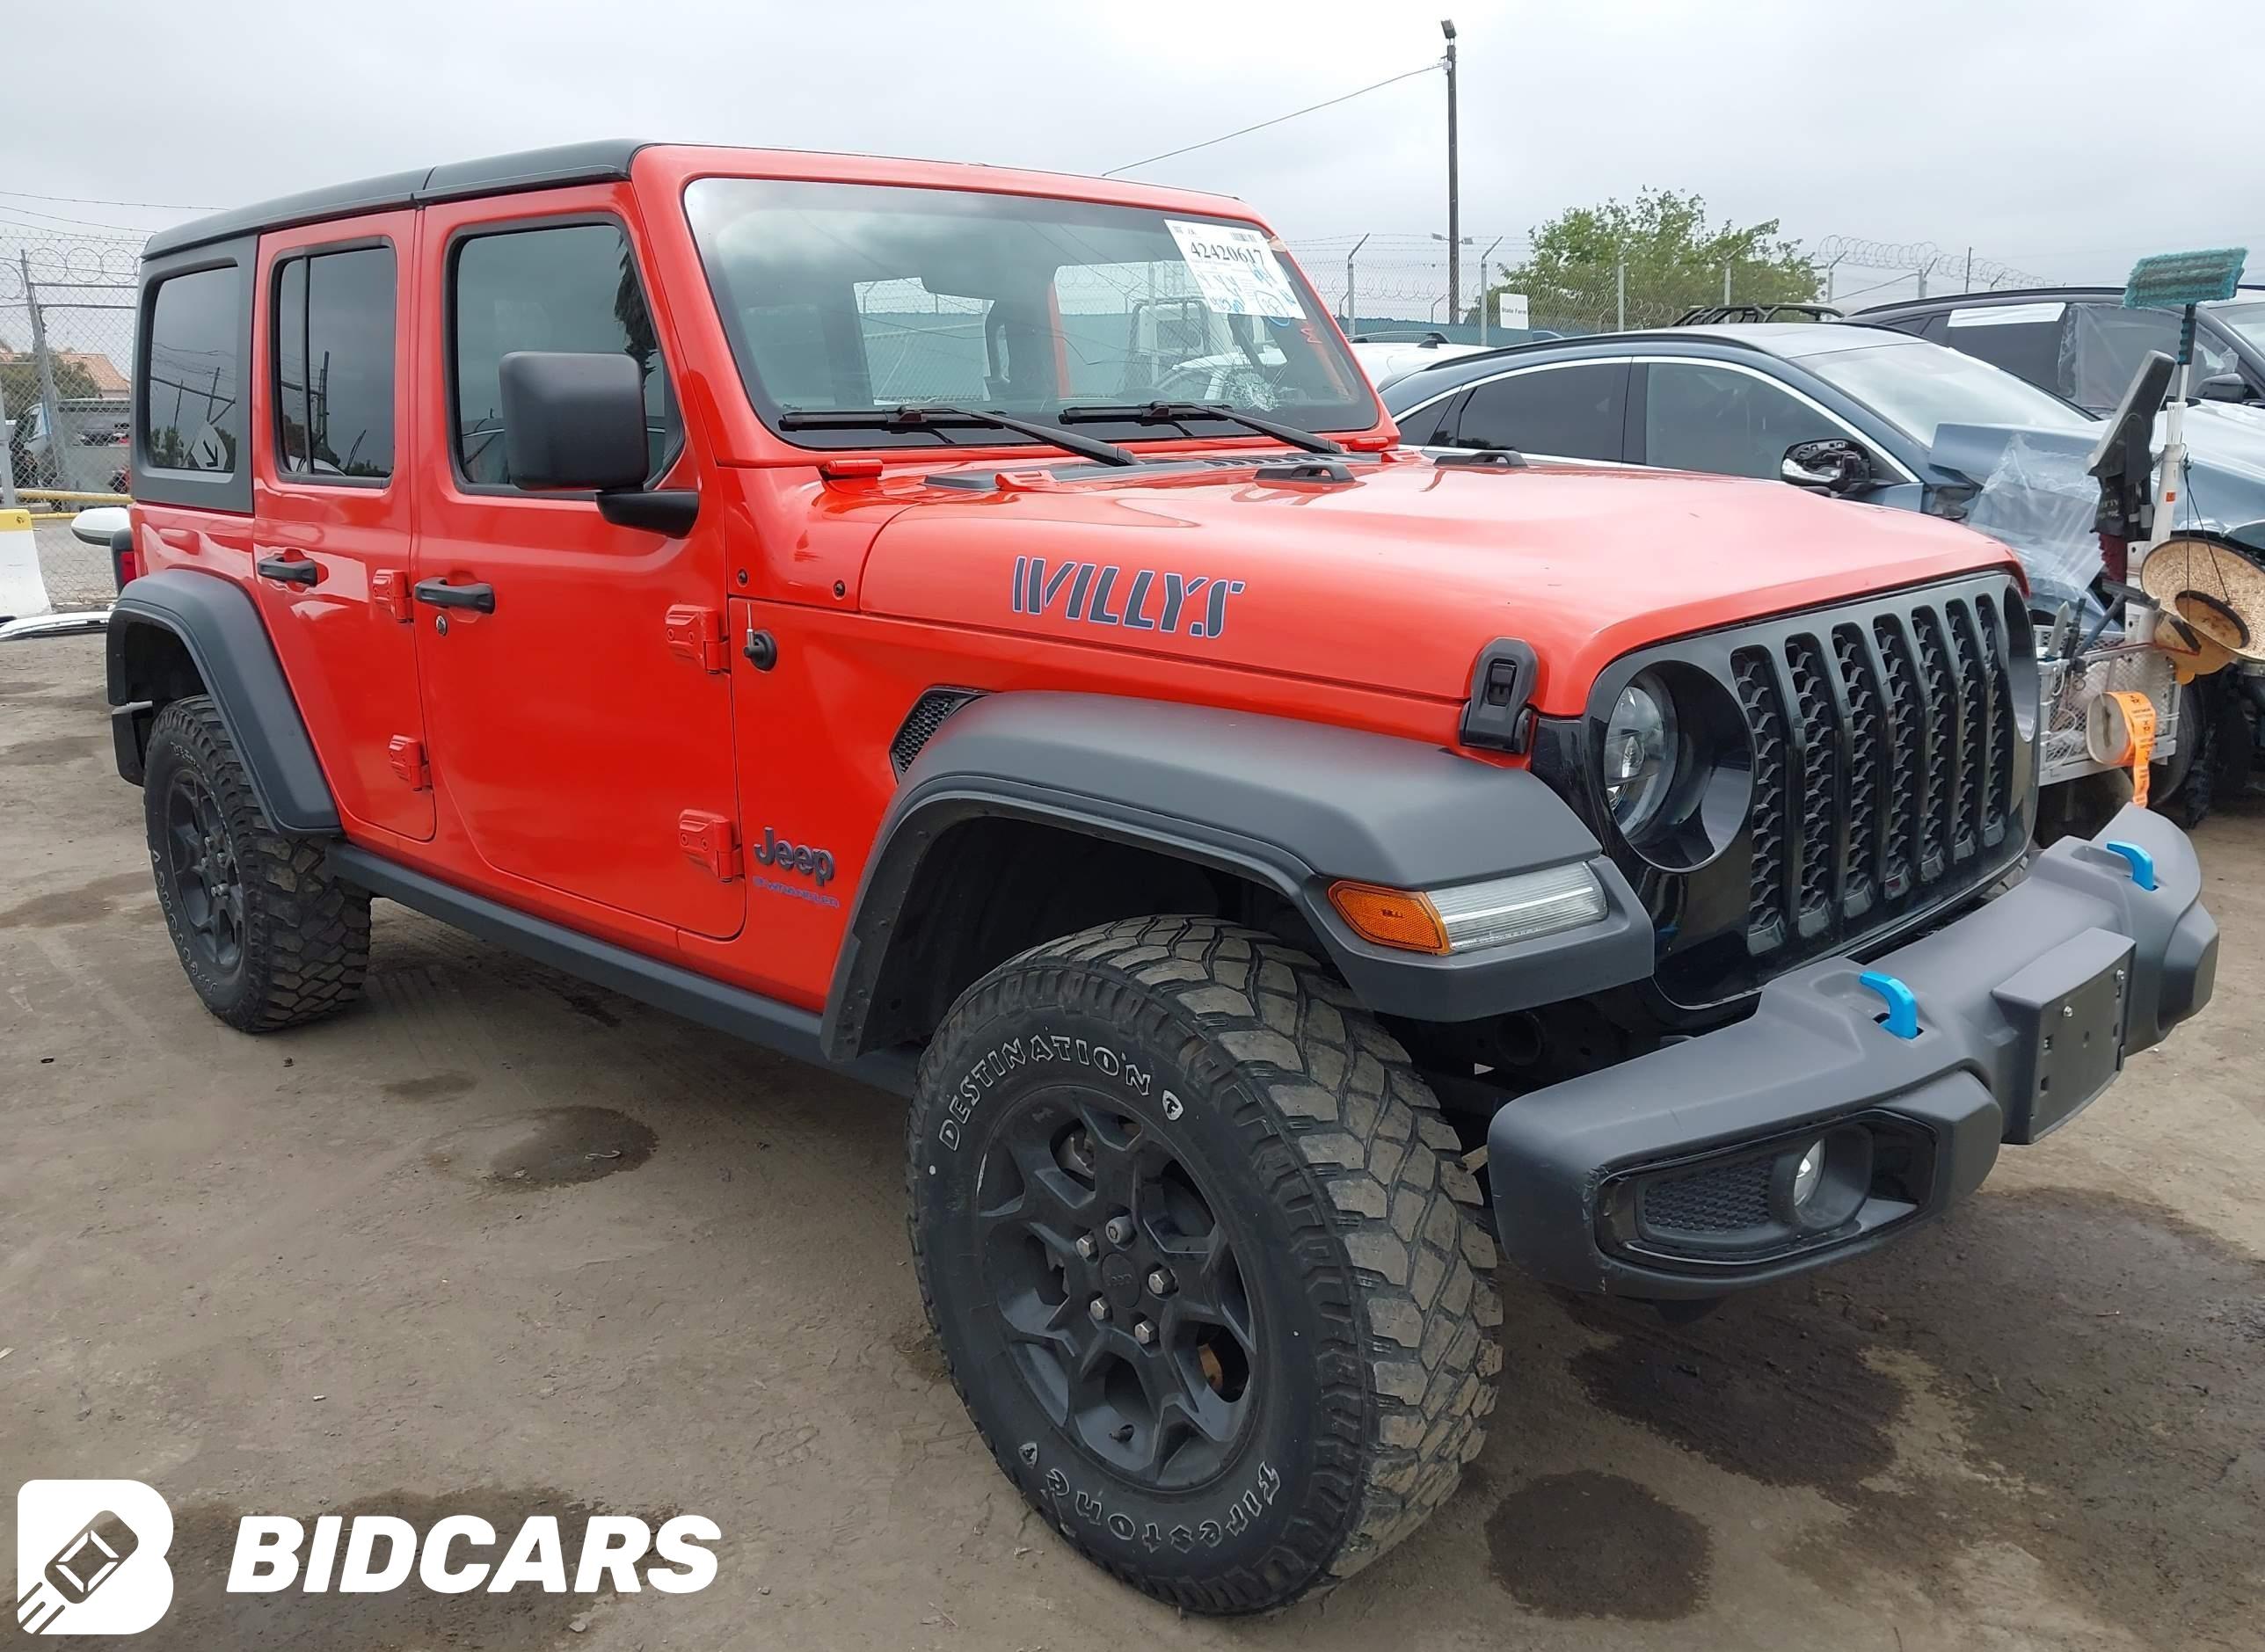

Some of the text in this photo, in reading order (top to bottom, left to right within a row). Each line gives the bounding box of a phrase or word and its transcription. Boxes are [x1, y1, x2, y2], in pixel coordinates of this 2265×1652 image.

[1013, 556, 1246, 637] WILLYS
[754, 826, 834, 887] Jeep
[939, 1035, 1151, 1151] DESTINATION
[1044, 1461, 1281, 1554] Firestone
